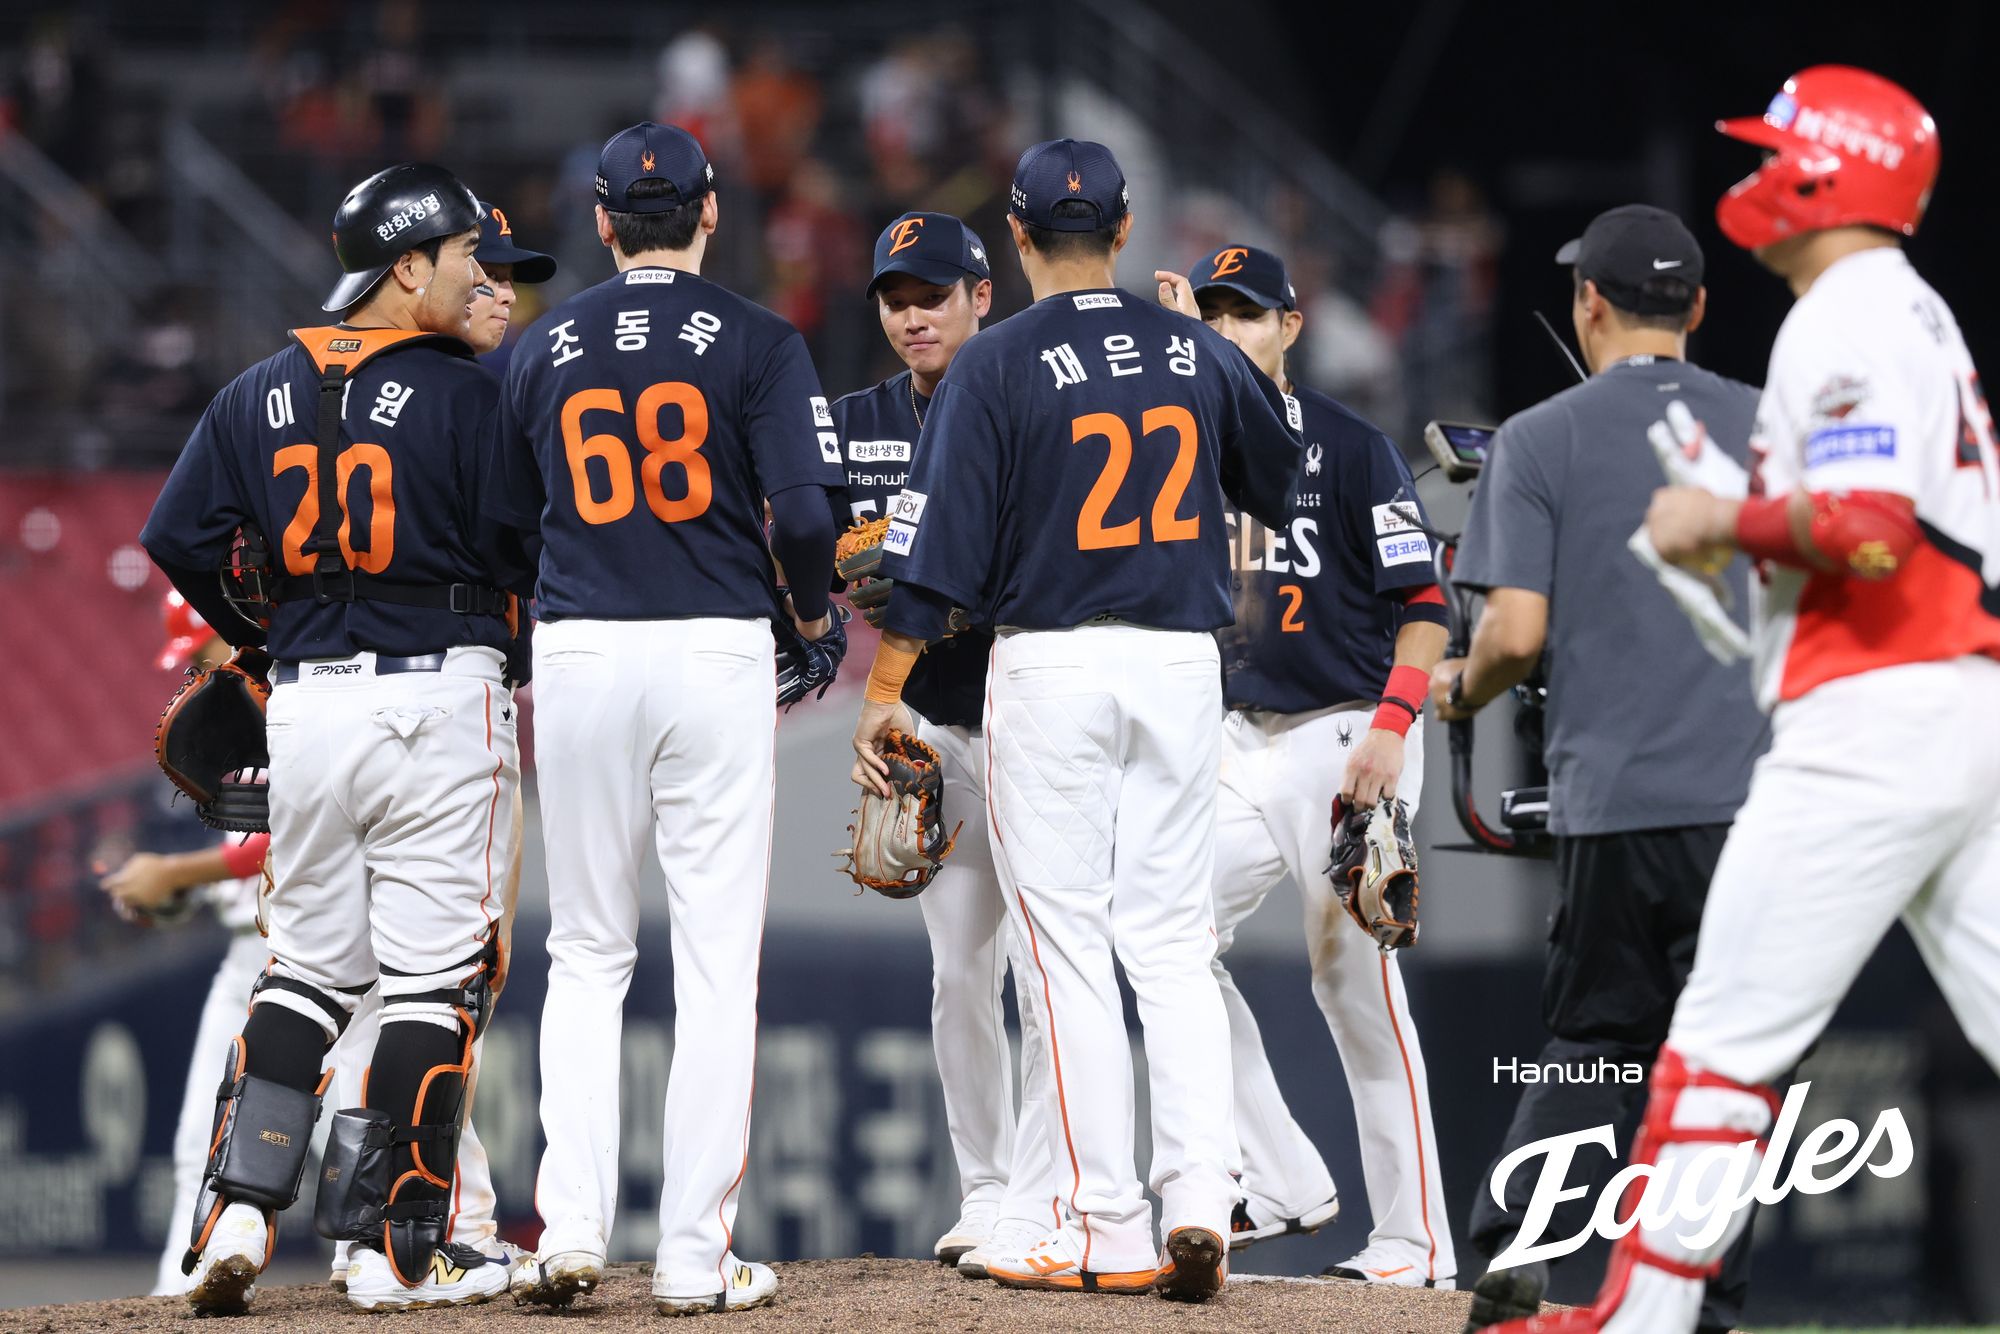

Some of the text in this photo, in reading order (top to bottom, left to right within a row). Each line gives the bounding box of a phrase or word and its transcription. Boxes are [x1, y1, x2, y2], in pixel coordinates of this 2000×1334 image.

[376, 193, 441, 242] 한화생명
[889, 218, 924, 256] E
[629, 271, 653, 281] 모두의
[1211, 248, 1248, 280] E
[1077, 296, 1101, 306] 모두의
[266, 378, 415, 429] 이원
[560, 381, 713, 525] 68
[855, 444, 905, 459] 한화생명
[1071, 405, 1200, 551] 22
[273, 443, 396, 574] 20
[1279, 585, 1304, 632] 2
[311, 664, 362, 676] SPYDER
